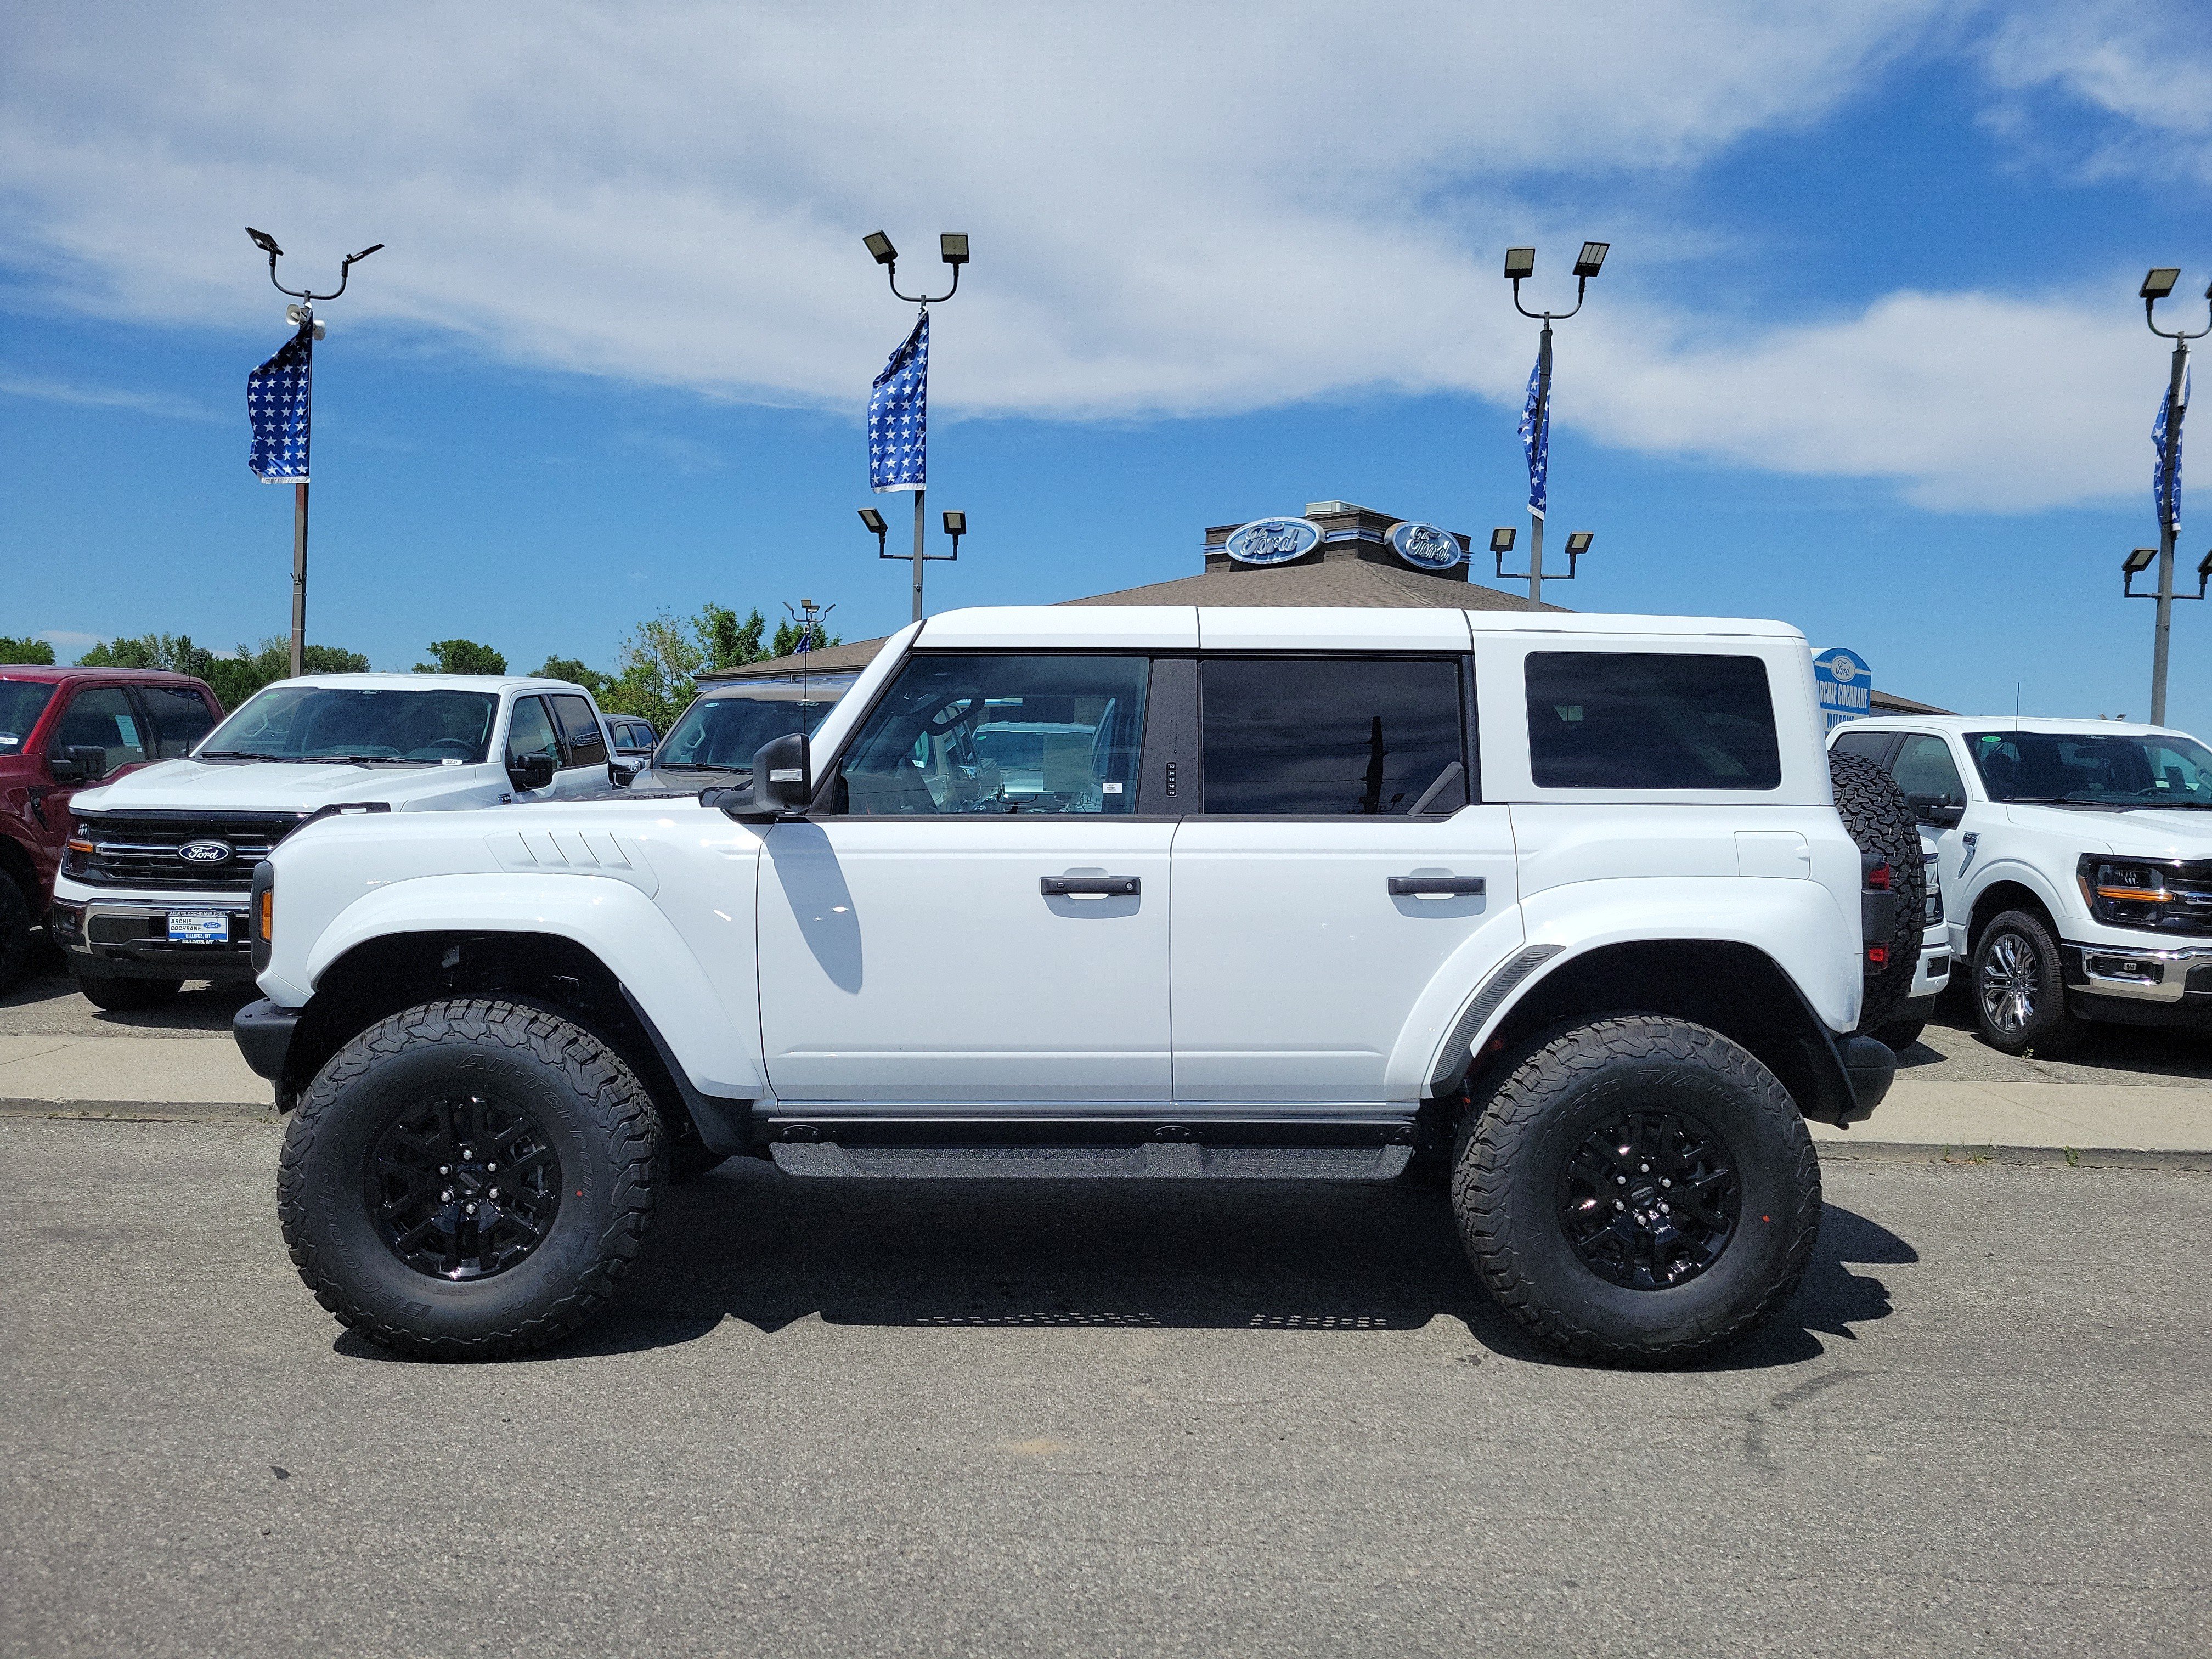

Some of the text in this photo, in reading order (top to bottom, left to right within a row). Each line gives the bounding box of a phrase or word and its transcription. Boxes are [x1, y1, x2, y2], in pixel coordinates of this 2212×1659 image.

[1240, 523, 1299, 556] Ford
[1406, 527, 1451, 562] Ford
[1836, 659, 1850, 676] Ford
[1838, 684, 1868, 709] COCHRANE
[188, 846, 219, 859] Ford
[318, 1109, 435, 1320] BFGoodrich
